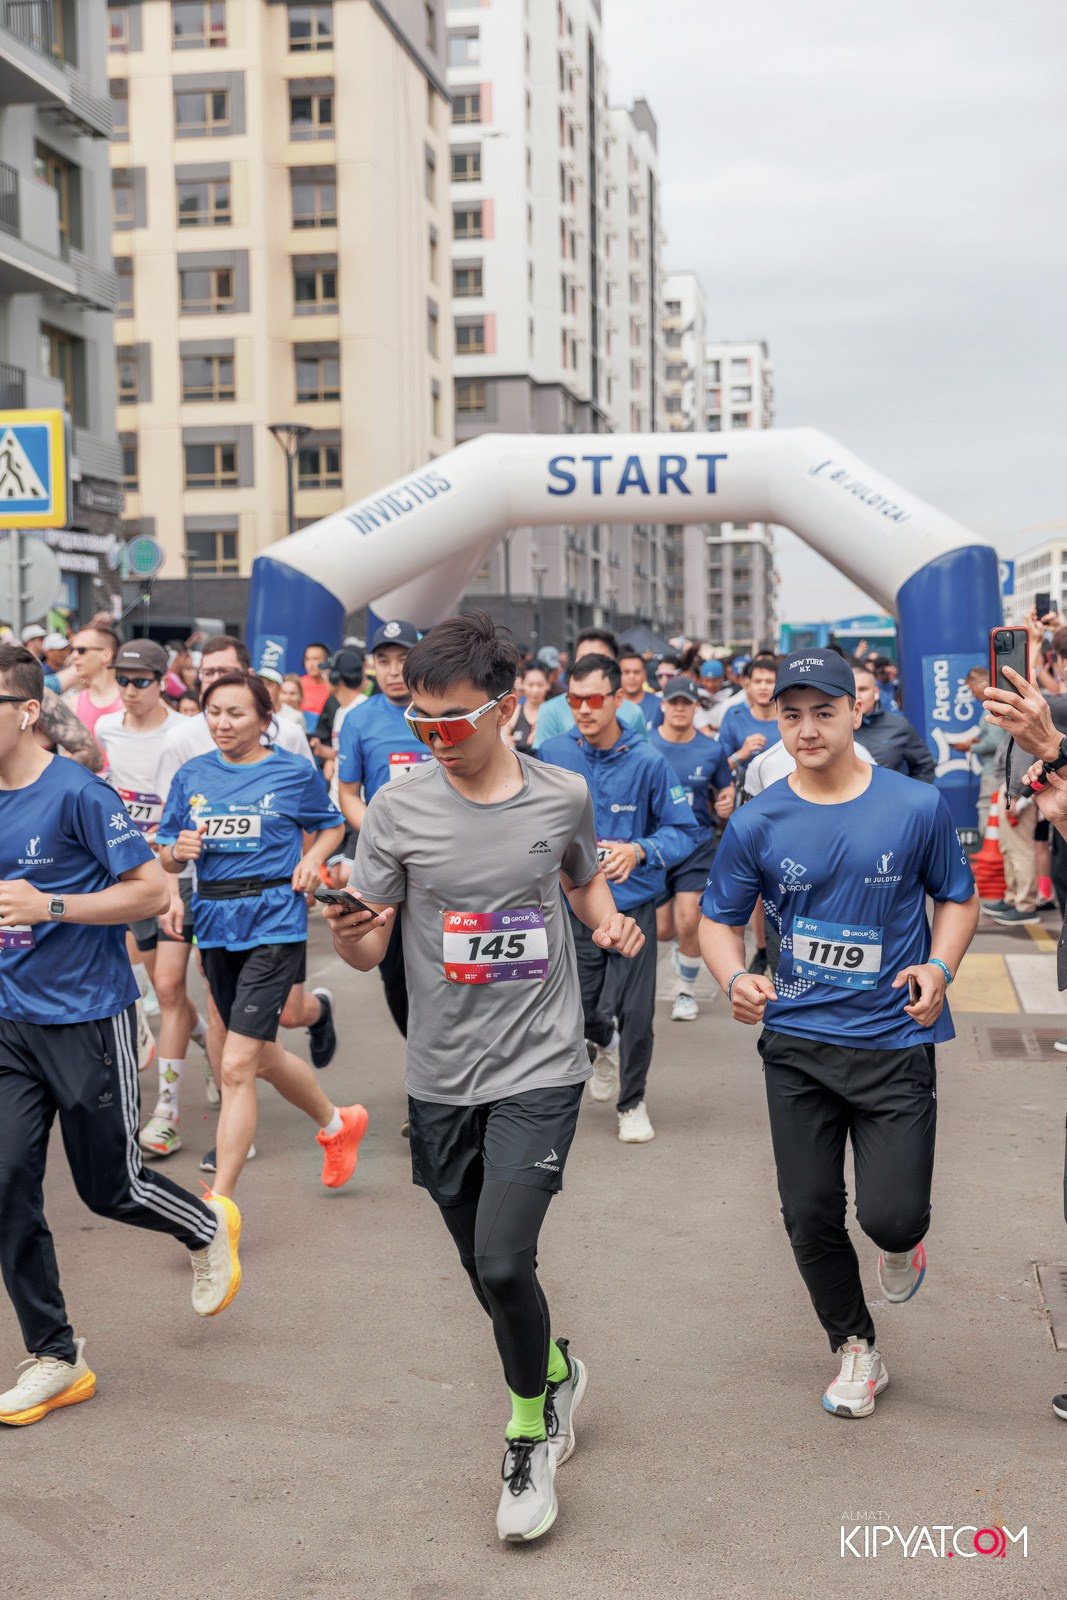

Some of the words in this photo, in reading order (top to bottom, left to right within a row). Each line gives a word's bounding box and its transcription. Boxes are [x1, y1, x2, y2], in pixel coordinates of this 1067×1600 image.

[547, 453, 728, 497] START
[344, 470, 451, 535] INVICTUS
[788, 658, 805, 670] NEW
[805, 657, 825, 667] YORK
[932, 659, 951, 723] Arena
[204, 818, 251, 837] 1759
[107, 832, 131, 848] Dream
[786, 884, 813, 892] GROUP
[448, 915, 462, 926] 10
[462, 918, 478, 926] KM
[510, 915, 530, 923] GROUP
[796, 920, 803, 929] 5
[804, 923, 818, 932] KM
[468, 933, 527, 961] 145
[808, 941, 864, 969] 1119
